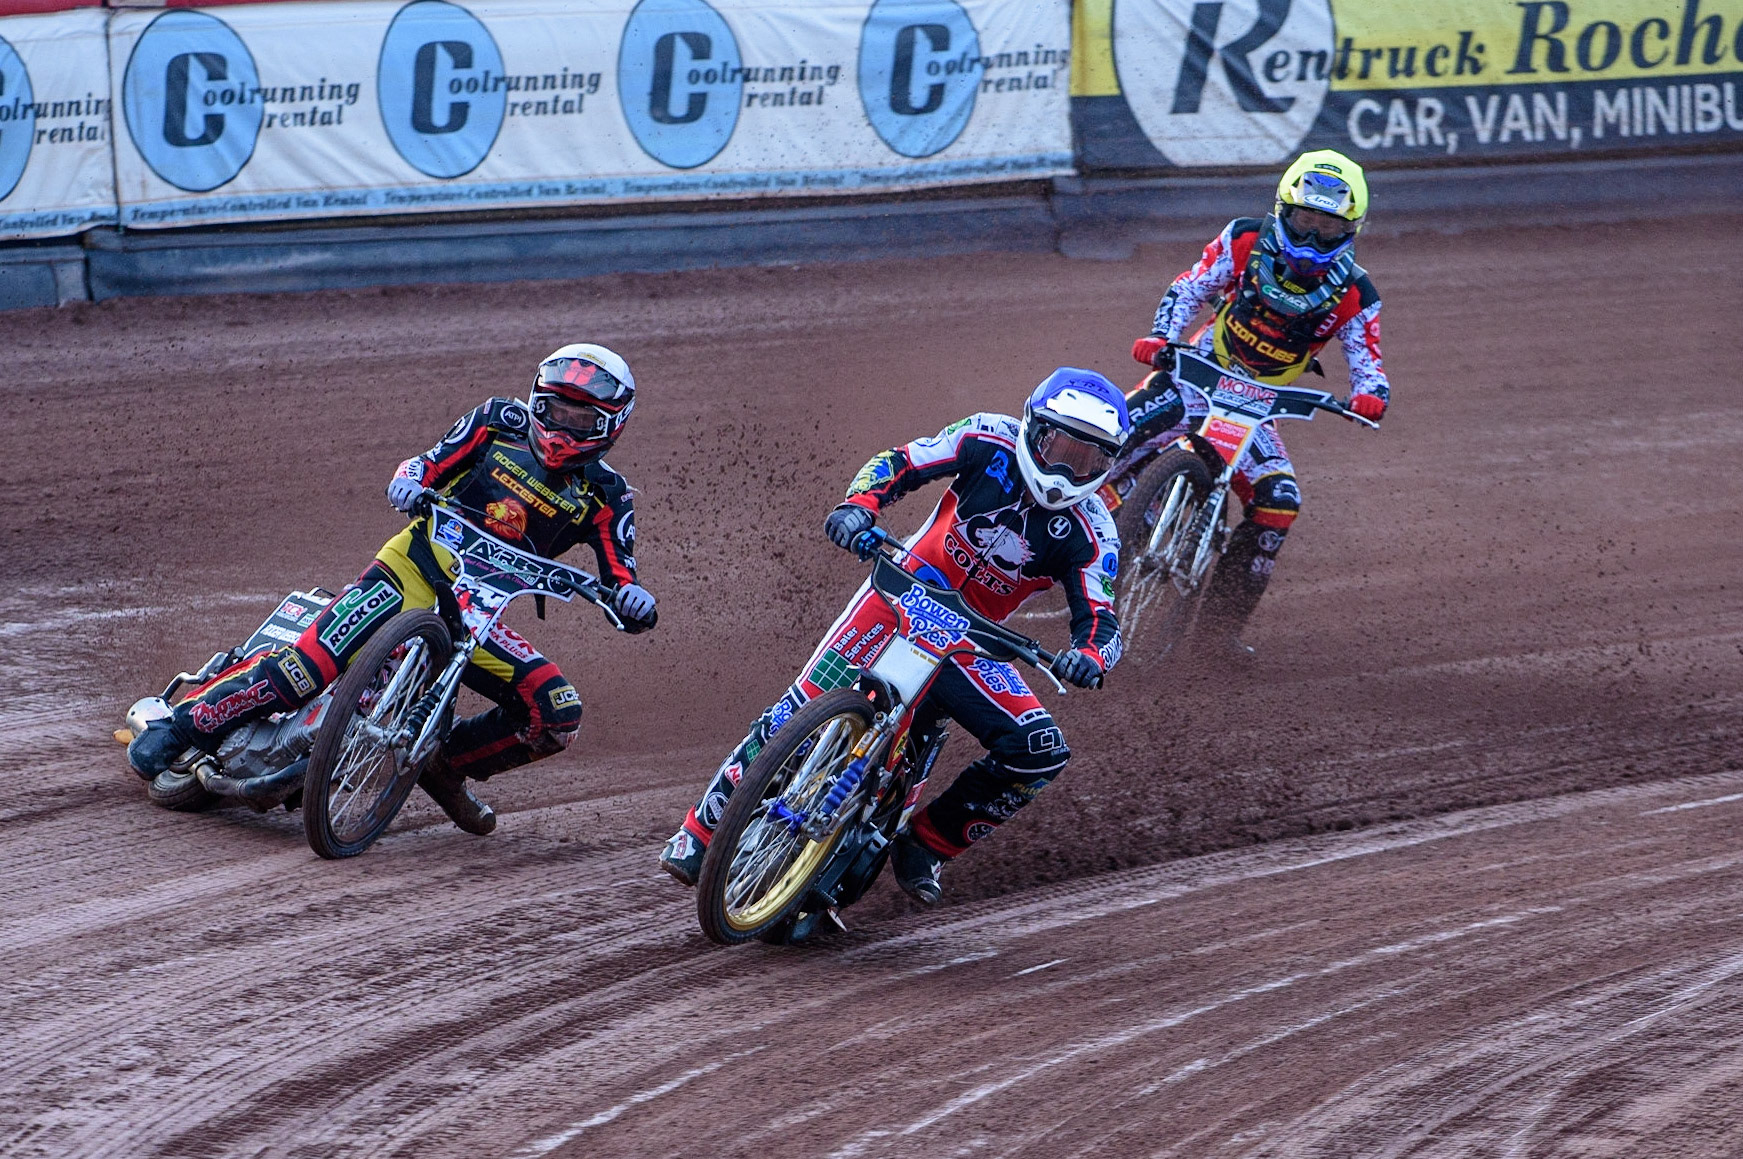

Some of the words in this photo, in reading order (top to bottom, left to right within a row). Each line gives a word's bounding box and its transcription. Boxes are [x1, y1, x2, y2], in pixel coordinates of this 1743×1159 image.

[1170, 0, 1486, 114] Rentruck
[1505, 0, 1743, 75] Roch
[745, 85, 824, 108] rental
[982, 69, 1057, 93] rental
[264, 105, 343, 129] rental
[508, 94, 584, 117] rental
[1346, 96, 1458, 154] CAR,
[1465, 91, 1583, 149] VAN,
[1226, 314, 1258, 347] LION
[1256, 341, 1298, 363] CUBS
[1128, 387, 1178, 422] RACE
[1217, 376, 1277, 406] MOTIVE
[491, 467, 558, 519] LEICESTER
[492, 450, 528, 479] ROGER
[526, 476, 577, 514] WEBSTER
[944, 532, 1017, 596] COLTS
[328, 604, 369, 648] ROCK
[367, 588, 394, 610] OIL
[900, 585, 969, 633] Bowen
[844, 622, 885, 661] Services
[909, 616, 949, 648] Pies
[284, 660, 311, 691] JCB
